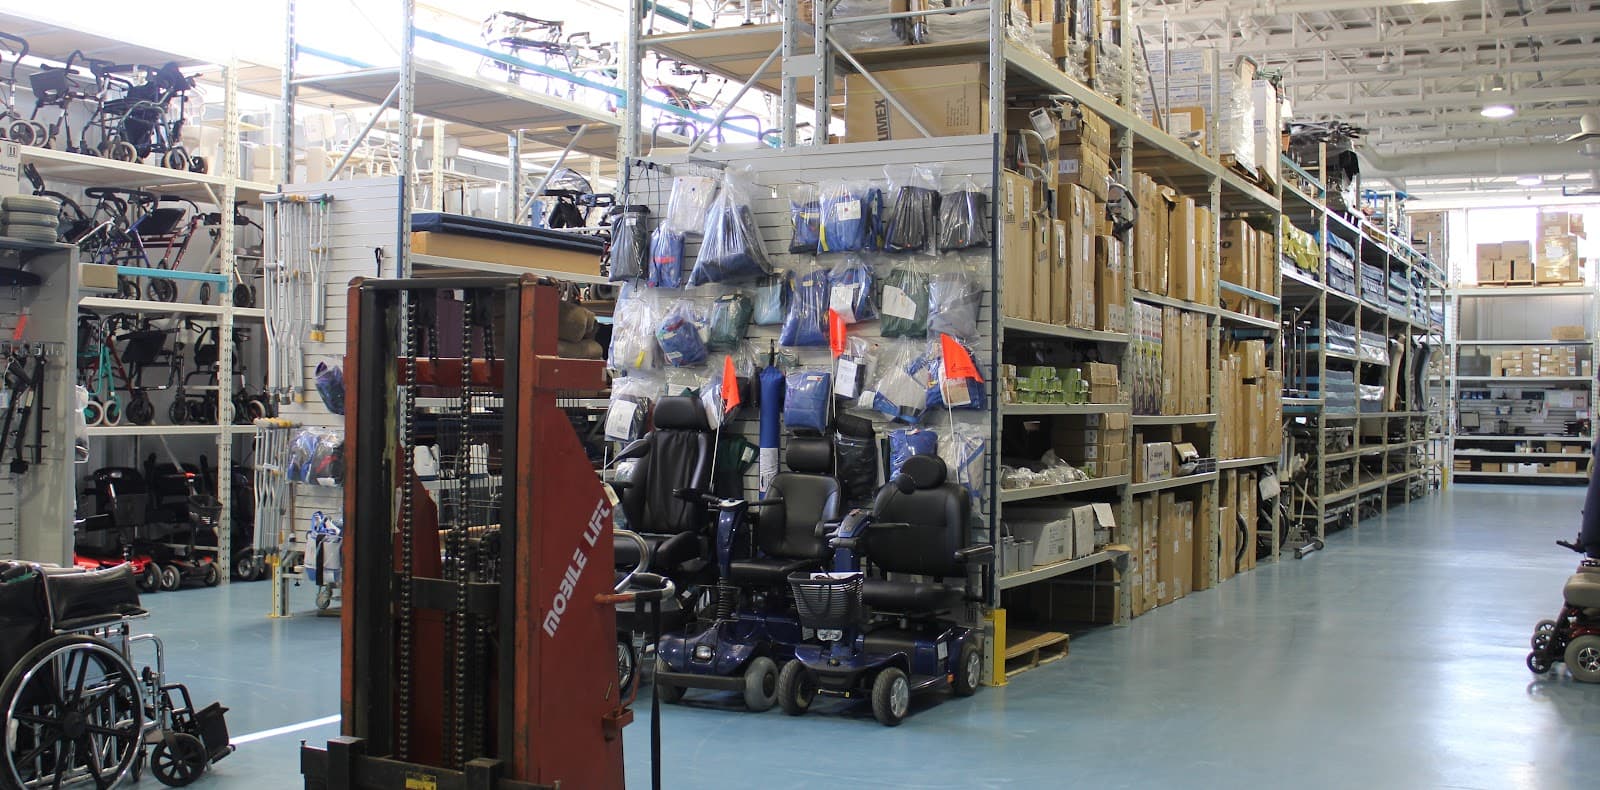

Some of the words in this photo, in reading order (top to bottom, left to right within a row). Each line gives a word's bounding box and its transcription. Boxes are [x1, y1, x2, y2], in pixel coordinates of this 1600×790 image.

[874, 98, 889, 141] UMEX
[543, 547, 588, 638] MOBILE
[583, 498, 610, 547] LIFT
